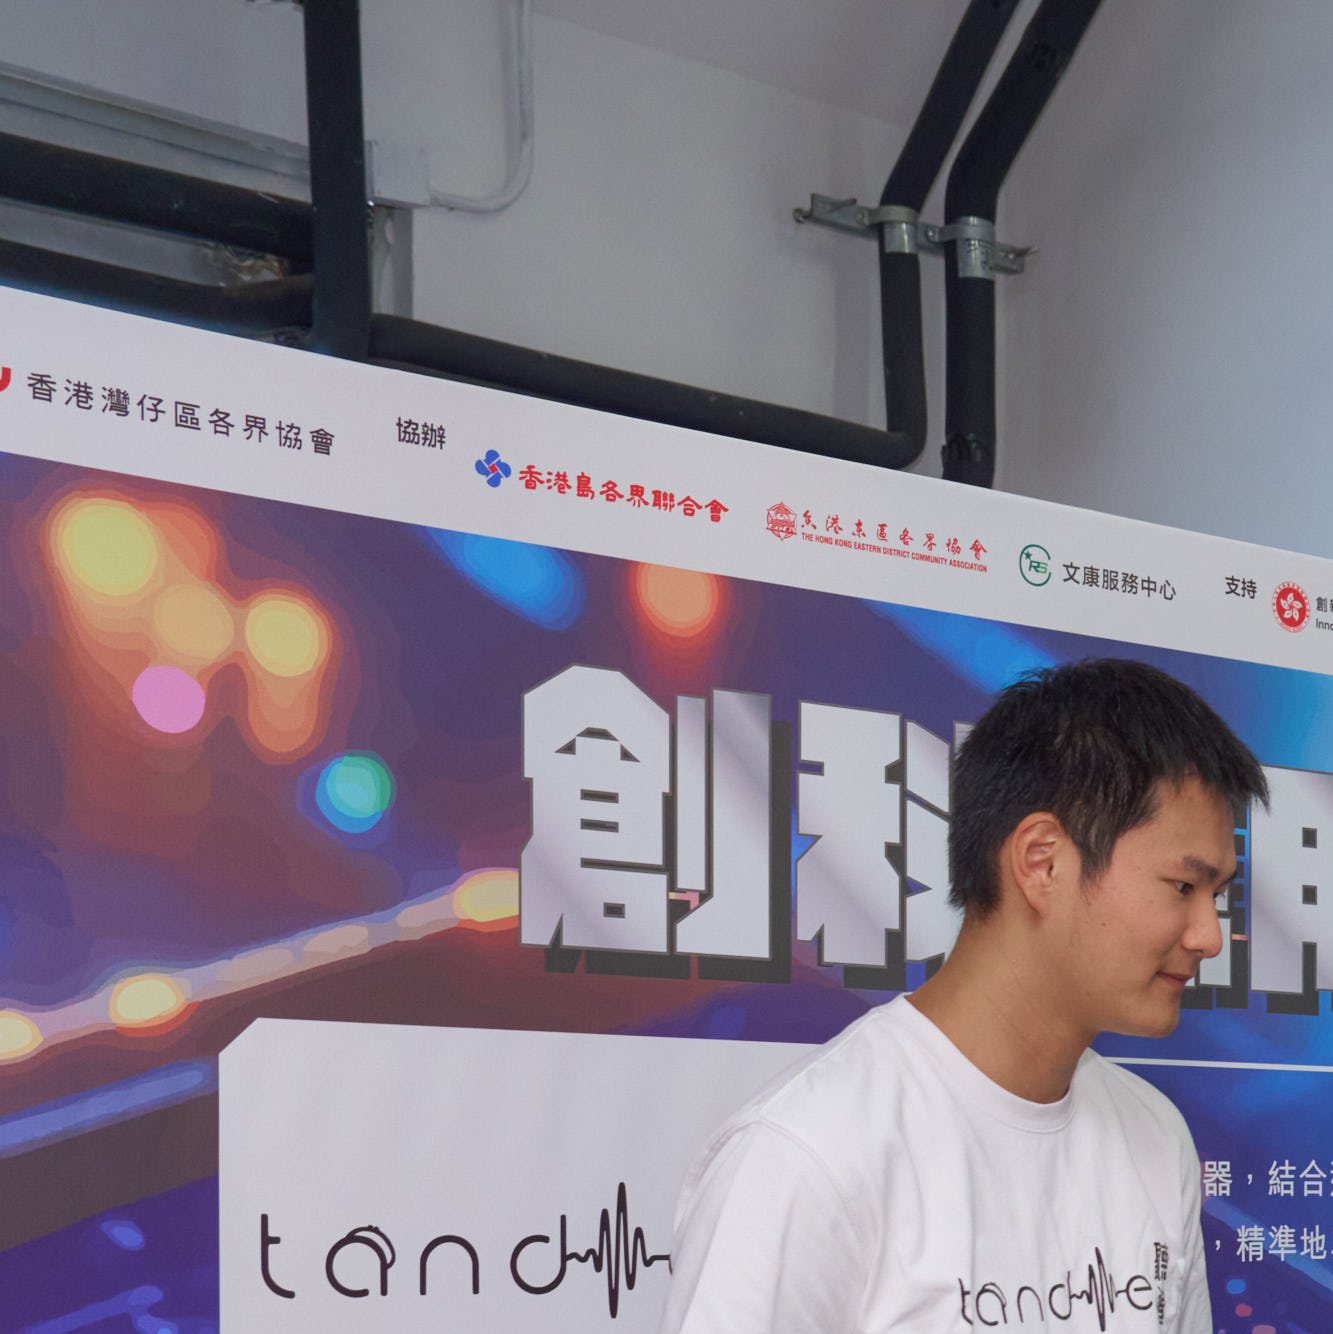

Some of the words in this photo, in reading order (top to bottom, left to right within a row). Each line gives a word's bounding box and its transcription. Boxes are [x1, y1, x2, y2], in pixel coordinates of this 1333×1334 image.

[26, 371, 336, 457] 香港灣仔區各界協會
[395, 416, 447, 450] 協辦
[518, 465, 729, 523] 香港島各界聯合會
[801, 532, 814, 542] THE
[815, 534, 834, 546] HONG
[834, 538, 853, 549] KONG
[853, 541, 882, 554] EASTERN
[882, 546, 910, 559] DISTRICT
[911, 551, 948, 566] COMMUNITY
[949, 559, 988, 573] ASSOCIATION
[1062, 561, 1177, 601] 文康服務中心
[1224, 575, 1258, 600] 支持
